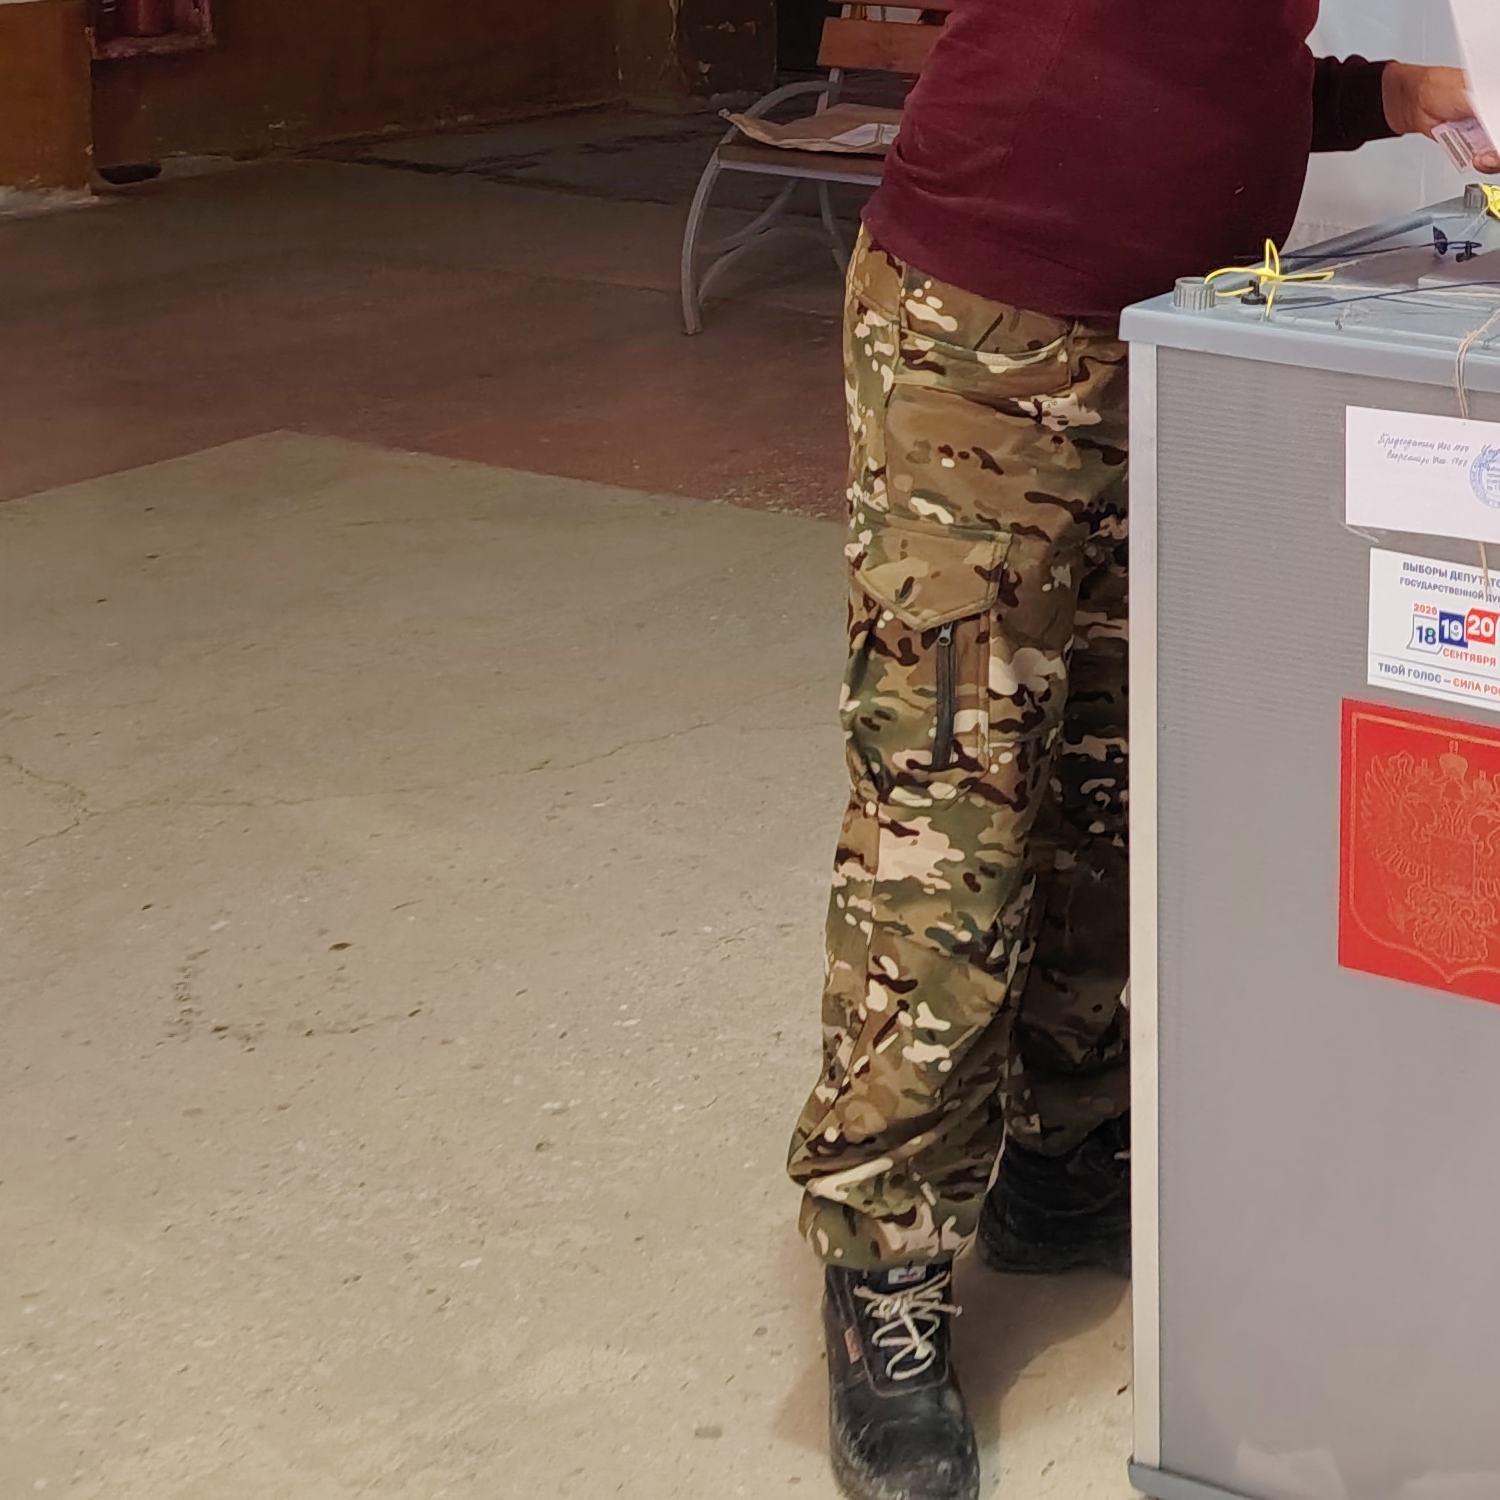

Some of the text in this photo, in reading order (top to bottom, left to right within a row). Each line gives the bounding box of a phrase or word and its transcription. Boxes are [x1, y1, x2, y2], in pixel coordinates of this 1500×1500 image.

[1402, 561, 1448, 578] ВЫБОРЫ
[1400, 576, 1484, 600] ГОСУДАРСТВЕННОЙ
[1416, 615, 1495, 645] 18 19 20
[1442, 647, 1496, 667] СЕНТЯБРЯ
[1378, 662, 1406, 676] ТВОЙ
[1407, 668, 1442, 683] ГОЛОС
[1452, 677, 1482, 692] СИЛА
